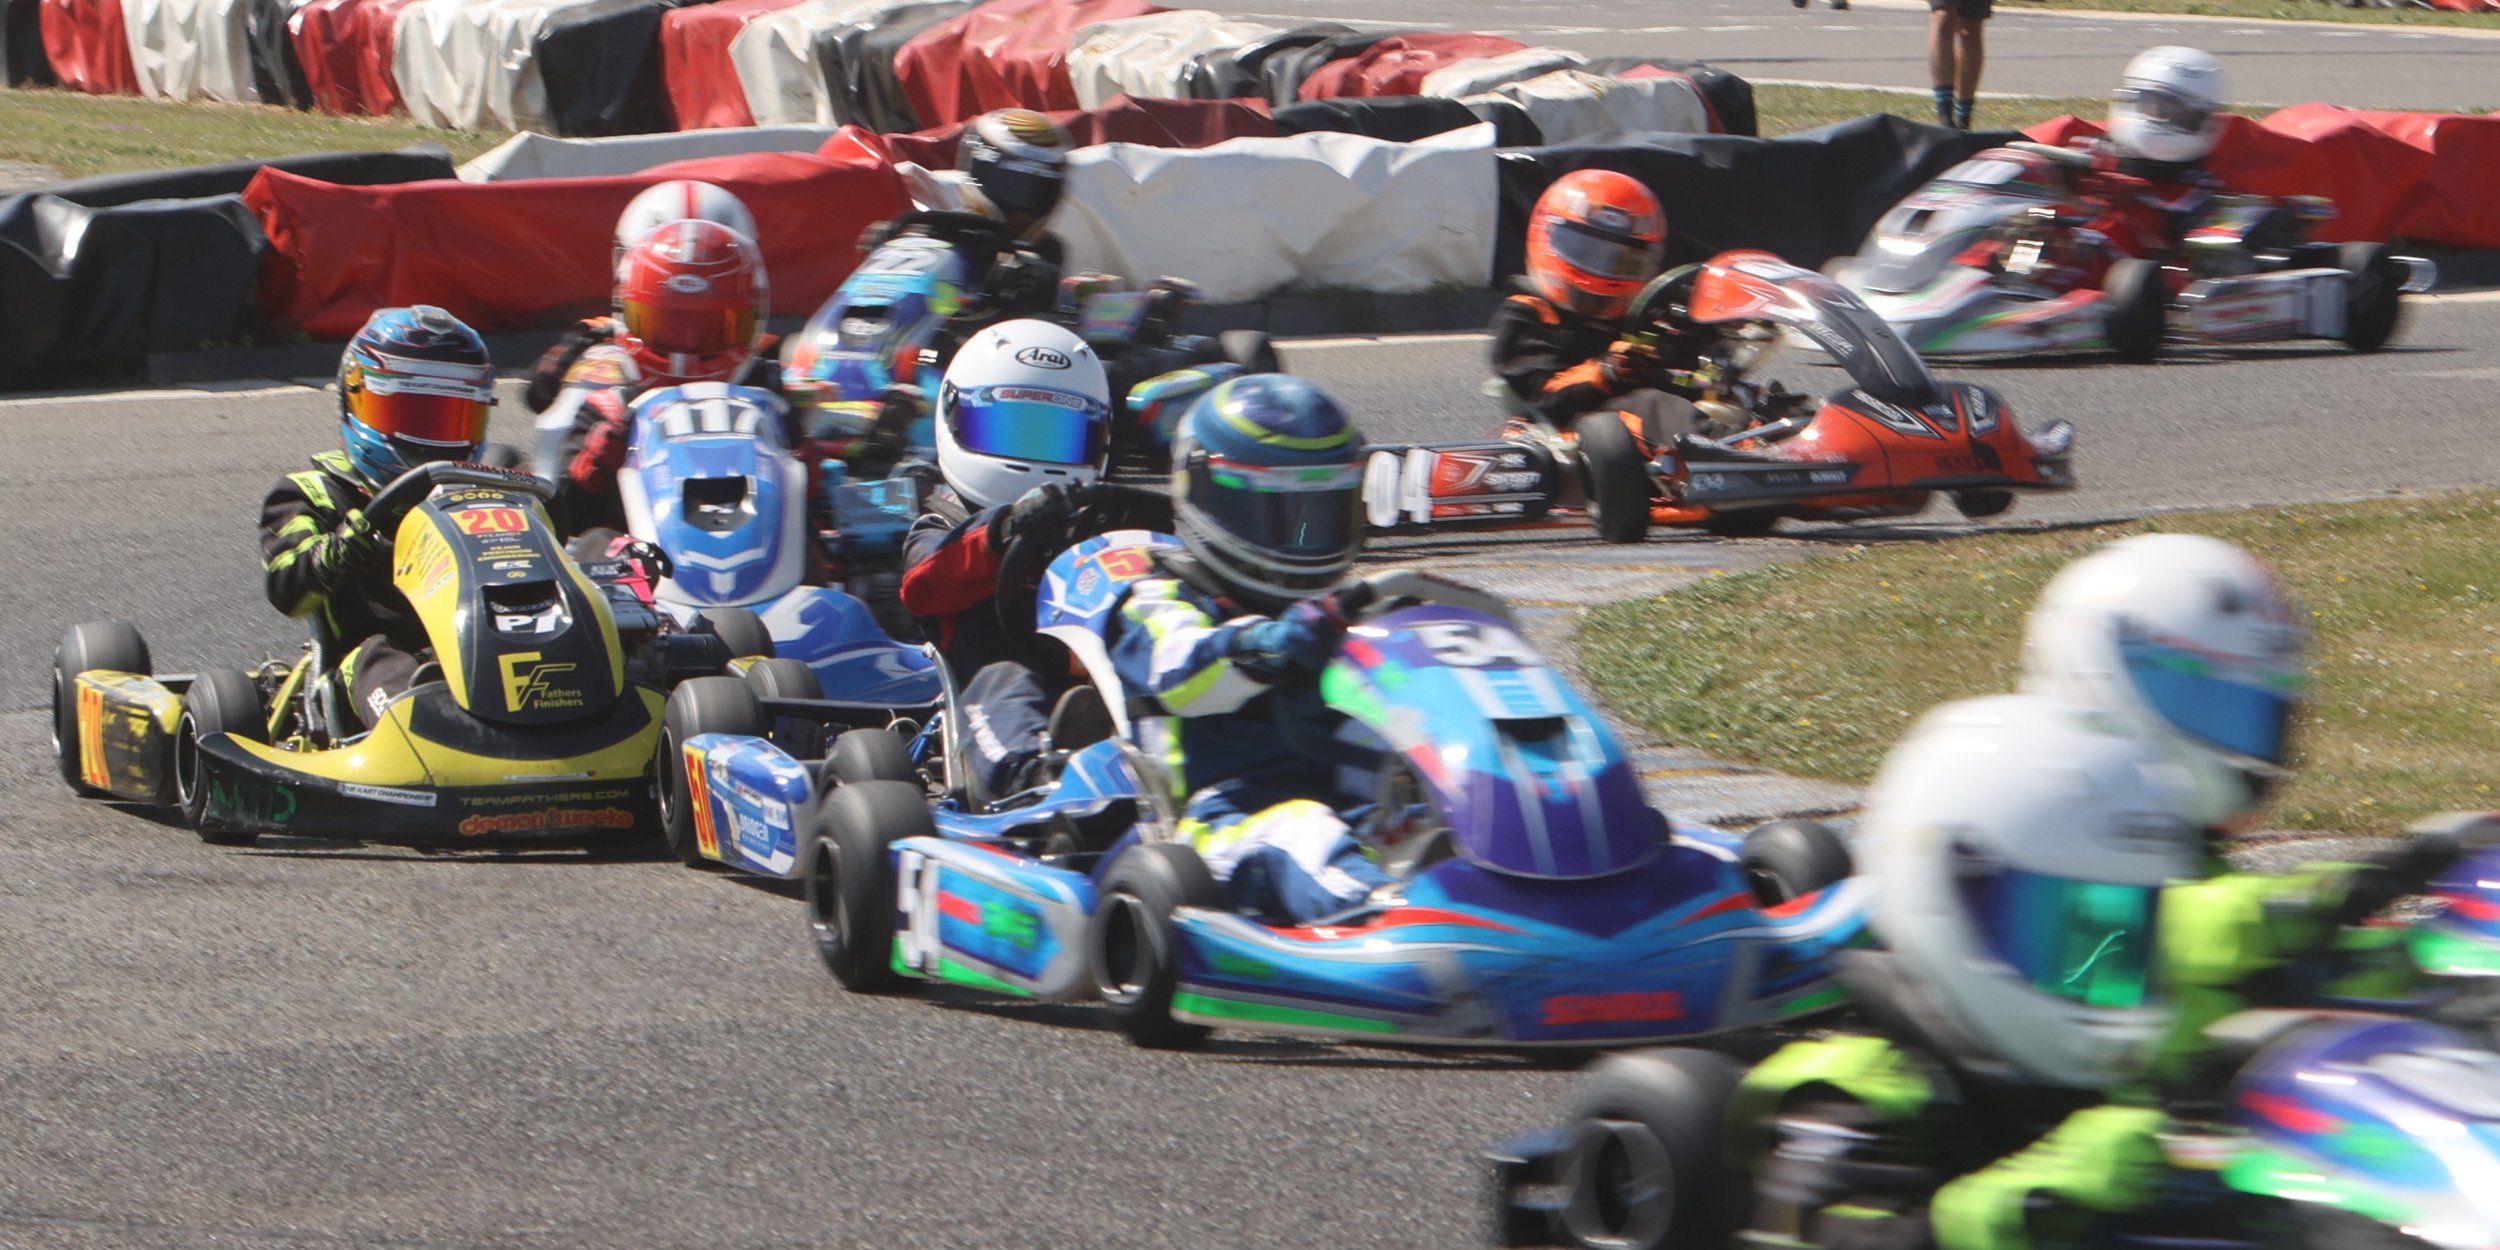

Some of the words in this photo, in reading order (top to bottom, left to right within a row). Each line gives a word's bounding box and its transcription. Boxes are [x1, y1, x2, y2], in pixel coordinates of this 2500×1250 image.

[1028, 348, 1065, 365] Arai
[654, 399, 760, 437] 117
[503, 471, 537, 488] Racing
[1361, 449, 1434, 527] 04
[461, 508, 525, 533] 20
[1099, 547, 1151, 577] 5
[1417, 624, 1547, 667] 54
[534, 699, 584, 709] Finishers
[541, 688, 582, 699] Fathers
[357, 787, 378, 795] KART
[378, 789, 433, 801] CHAMPIONSHIP
[460, 788, 630, 806] TEAMFATHERS.COM
[459, 813, 546, 836] demon
[898, 850, 944, 978] 54
